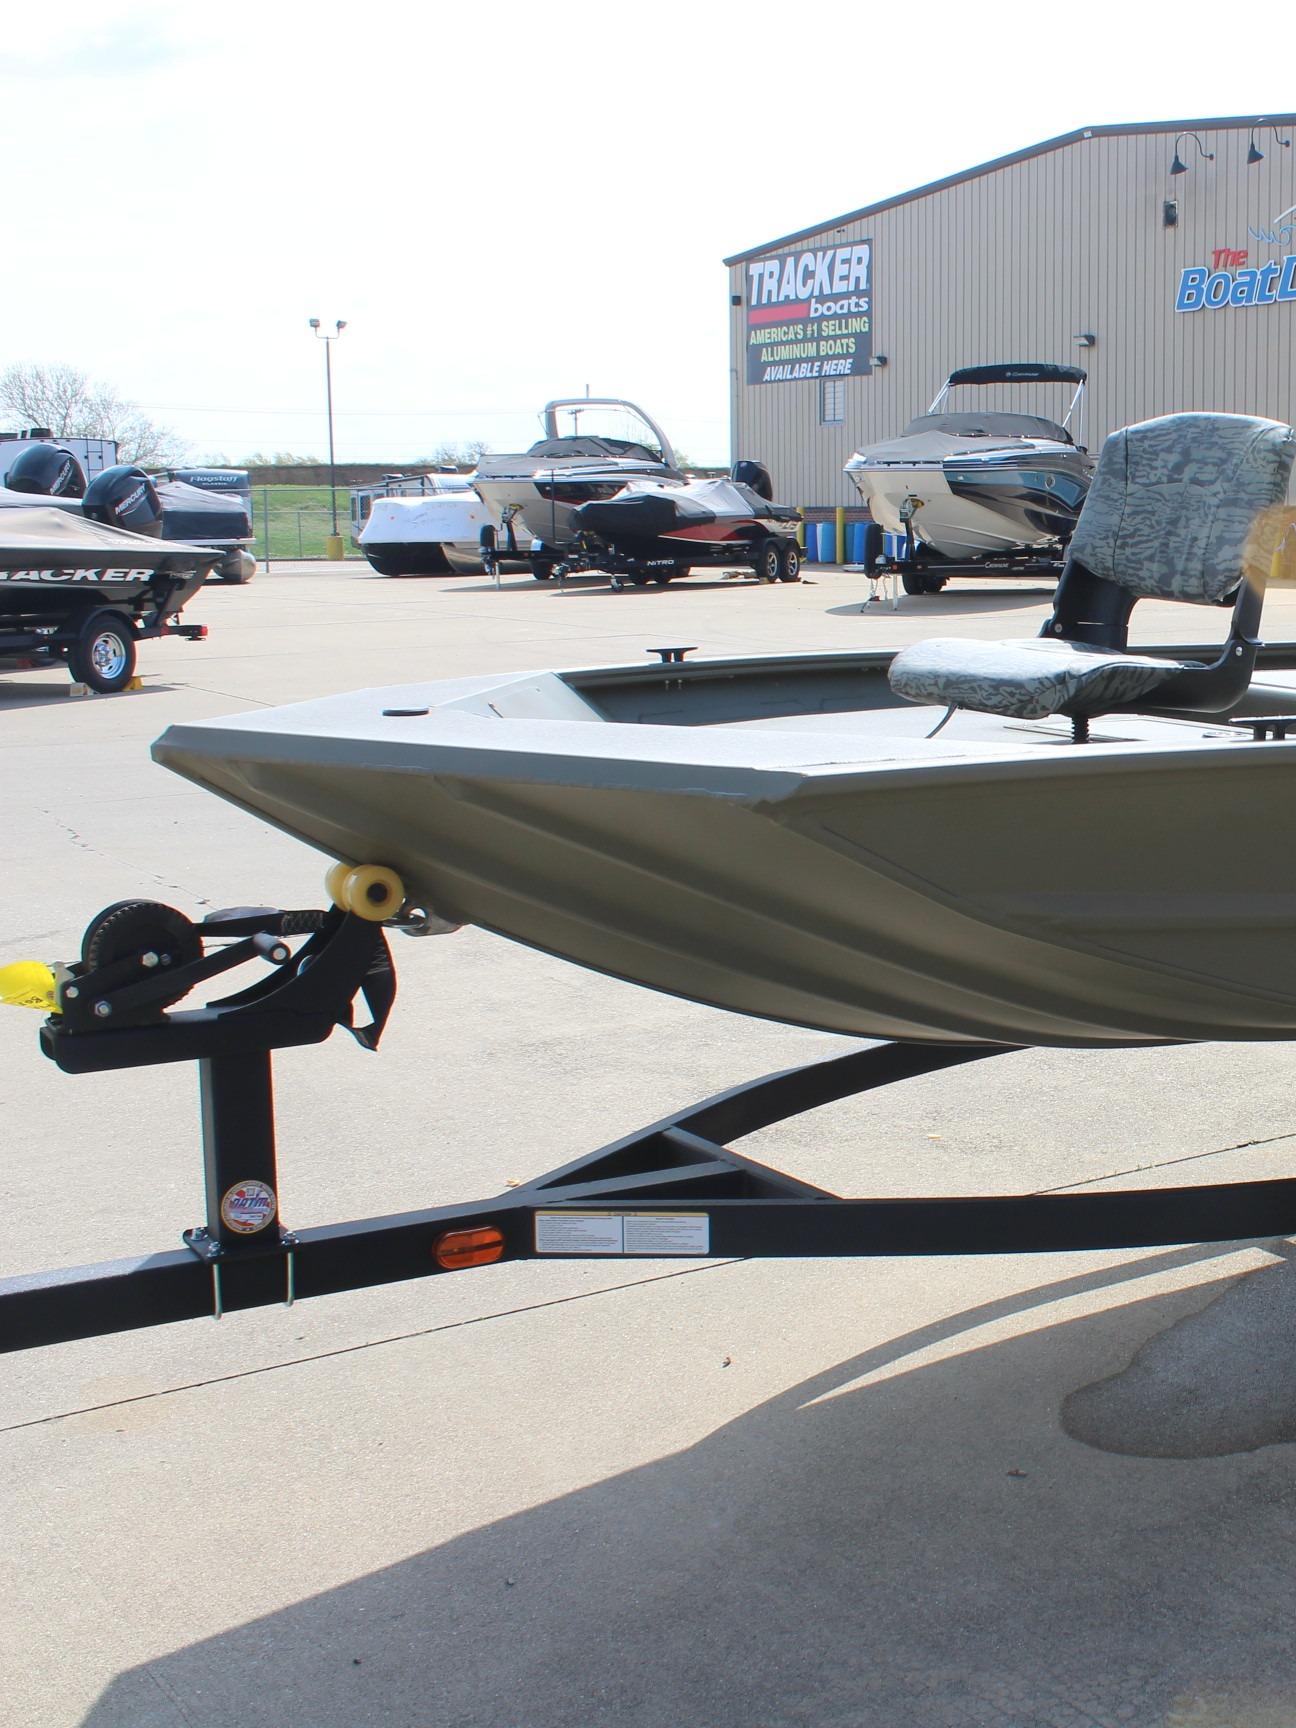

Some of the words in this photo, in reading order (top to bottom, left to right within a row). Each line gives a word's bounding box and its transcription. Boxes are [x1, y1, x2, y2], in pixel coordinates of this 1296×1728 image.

[1211, 247, 1249, 270] The
[749, 244, 869, 305] TRACKER
[810, 296, 869, 318] boats
[750, 324, 804, 345] AMERICA'S
[821, 317, 869, 336] SELLING
[760, 341, 817, 363] ALUMINUM
[819, 337, 856, 356] BOATS
[763, 362, 820, 381] AVAILABLE
[821, 359, 853, 375] HERE
[114, 482, 147, 516] MERCURY
[646, 559, 675, 567] NITRO
